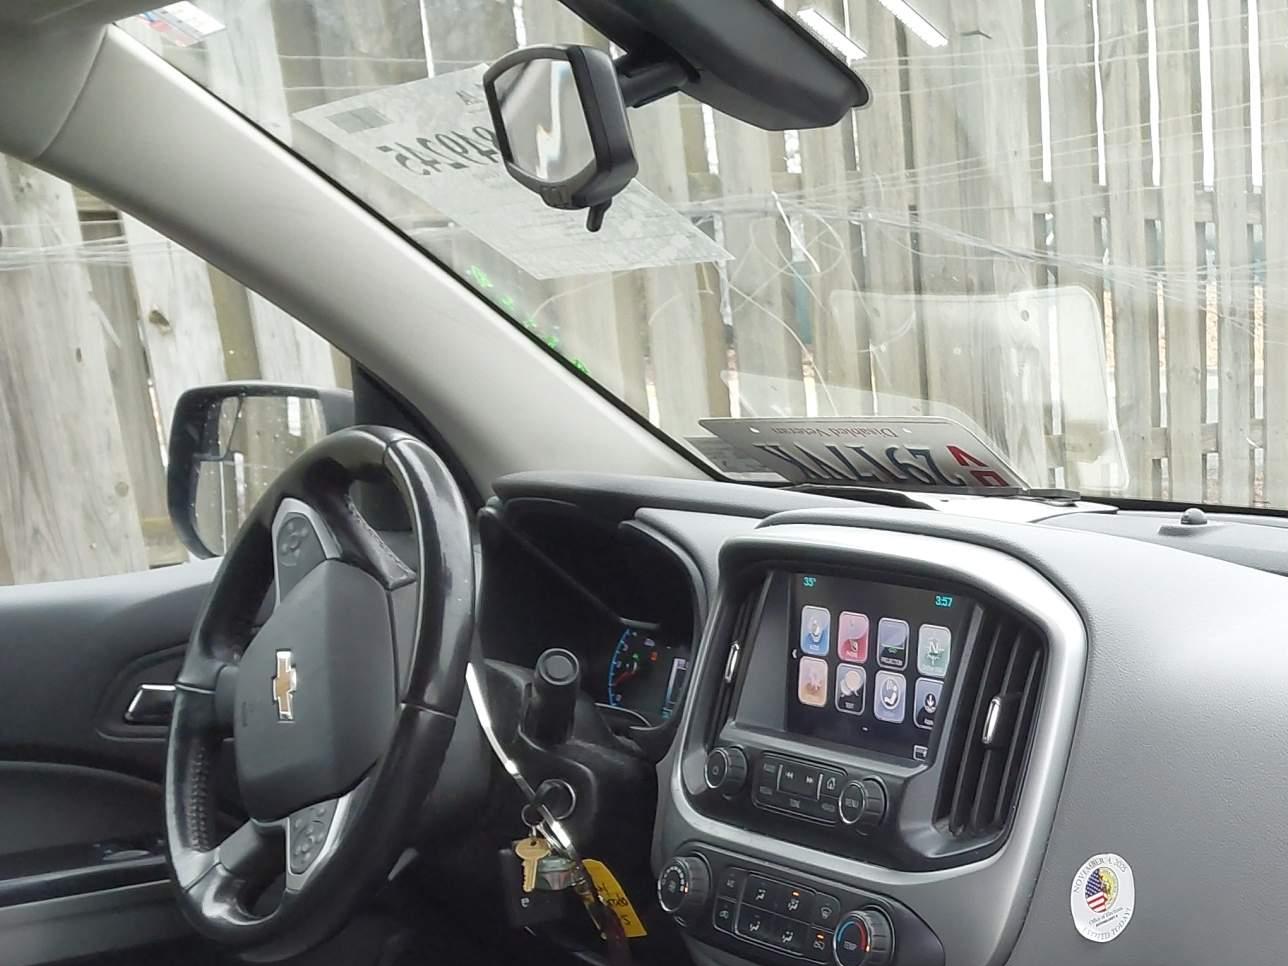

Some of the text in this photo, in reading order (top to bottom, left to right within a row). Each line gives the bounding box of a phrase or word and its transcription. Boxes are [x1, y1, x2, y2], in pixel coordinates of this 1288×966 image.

[769, 425, 900, 439] Disabled Veteran
[935, 596, 953, 608] 3:57
[1073, 857, 1105, 892] NOVEMBER
